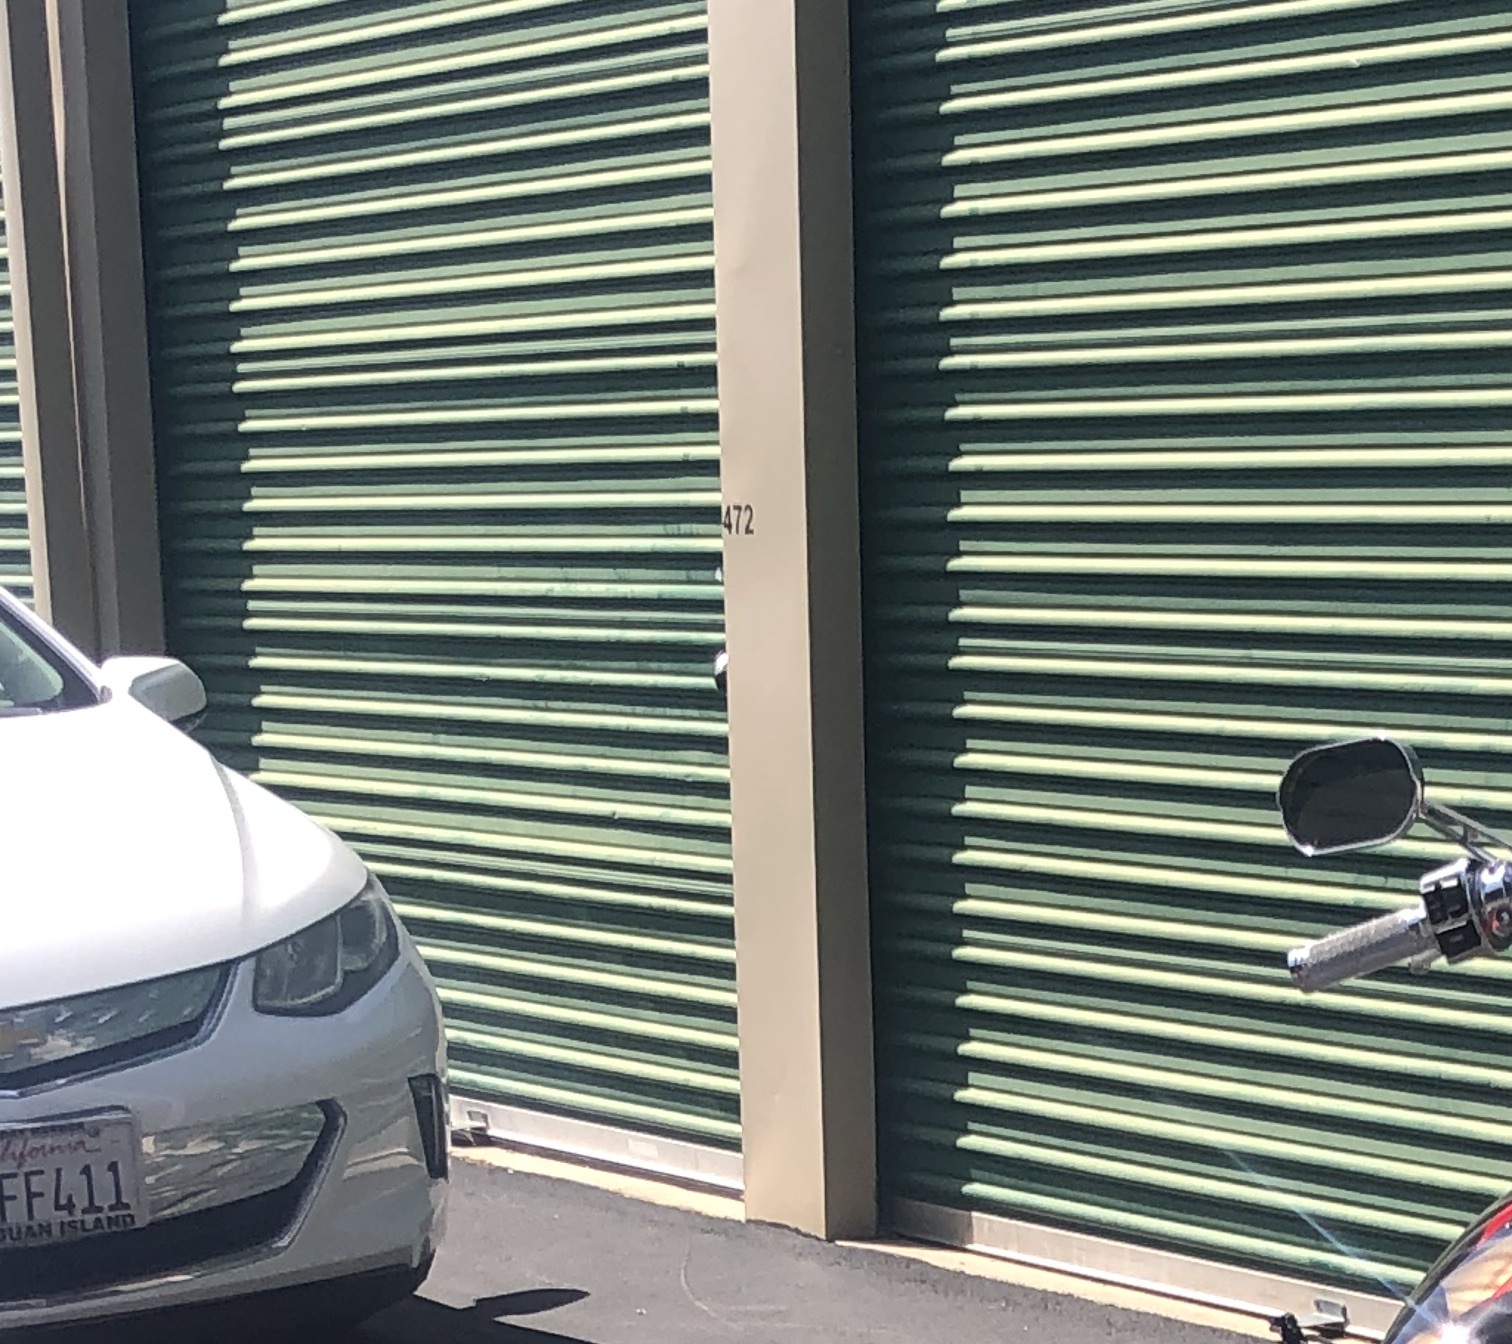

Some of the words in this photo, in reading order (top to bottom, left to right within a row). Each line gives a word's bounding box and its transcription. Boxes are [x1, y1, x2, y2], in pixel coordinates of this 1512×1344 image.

[722, 504, 754, 535] 472
[0, 1160, 131, 1222] FF411
[59, 1213, 136, 1238] ISLAND
